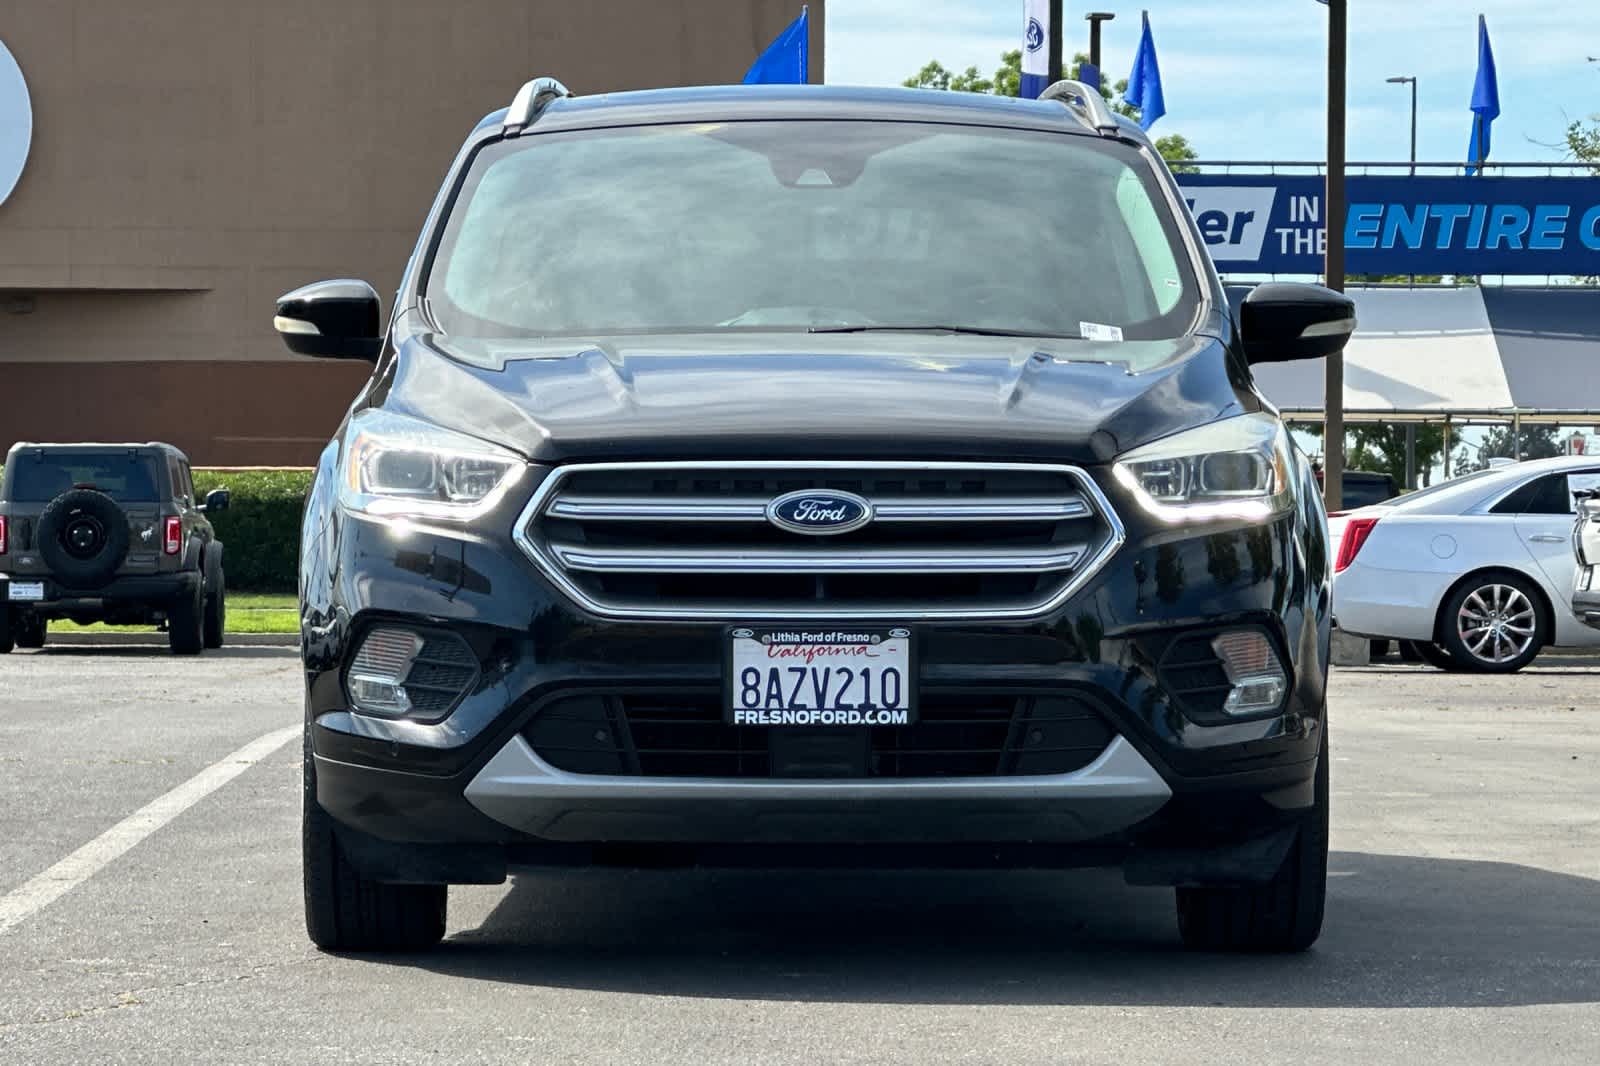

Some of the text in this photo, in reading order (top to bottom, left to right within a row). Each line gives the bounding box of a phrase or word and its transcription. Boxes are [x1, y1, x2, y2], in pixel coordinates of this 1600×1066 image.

[1290, 196, 1319, 223] IN
[1344, 204, 1570, 250] ENTIRE
[1274, 228, 1327, 255] THE
[793, 499, 847, 521] Ford
[771, 632, 870, 642] Lithia Ford of Fresno
[767, 643, 880, 665] California
[741, 666, 901, 709] 8AZV210
[734, 710, 908, 725] FRESNOFORD.COM
